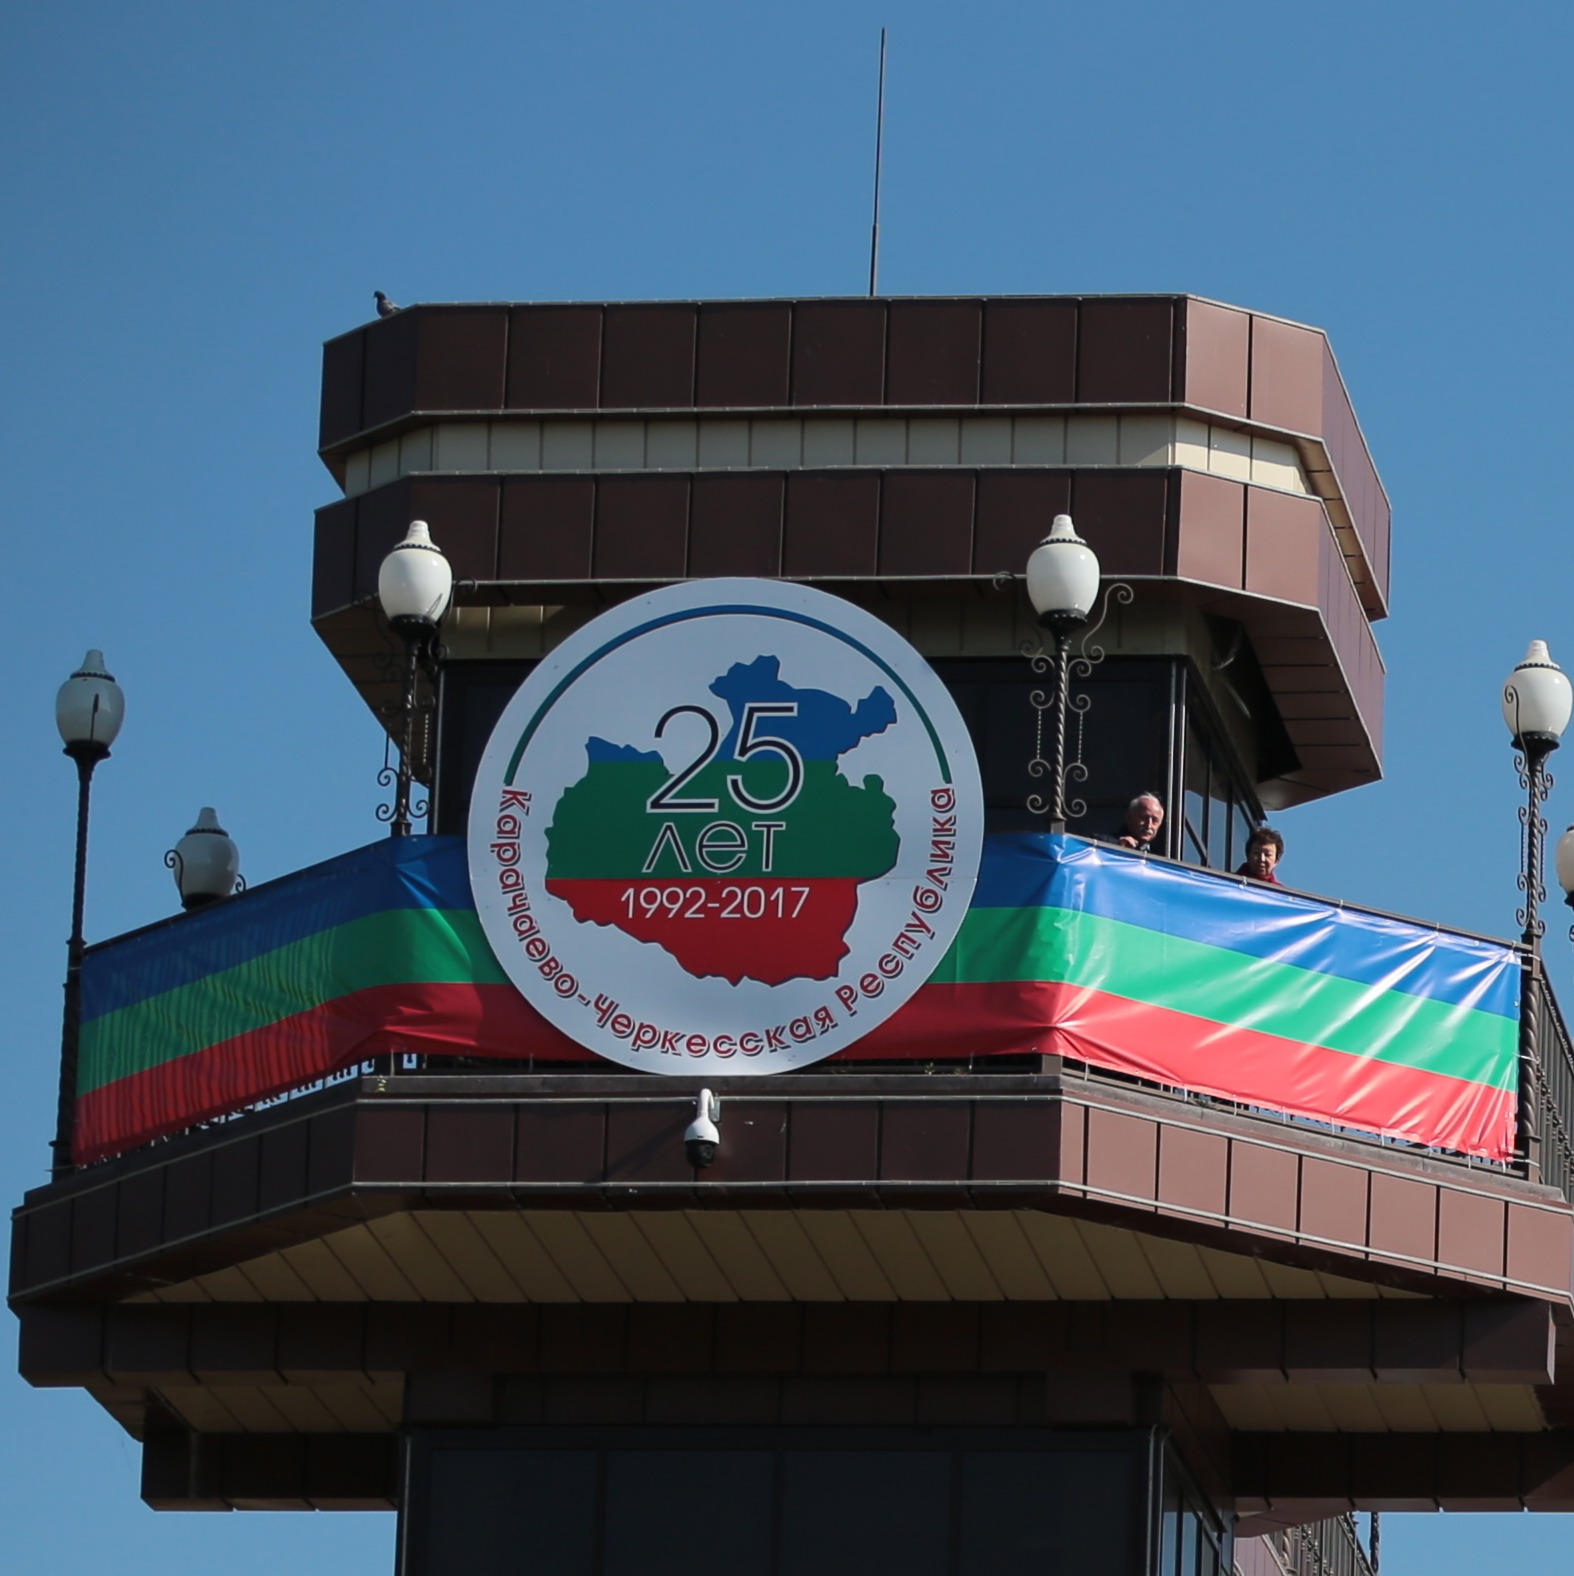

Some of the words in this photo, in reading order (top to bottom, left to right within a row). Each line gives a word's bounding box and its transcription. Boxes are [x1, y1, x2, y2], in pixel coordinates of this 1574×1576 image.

[646, 701, 804, 813] 25
[490, 787, 836, 1058] Карачаево-Черкесская
[834, 787, 957, 1018] Республика
[620, 886, 810, 919] 1992-2017
